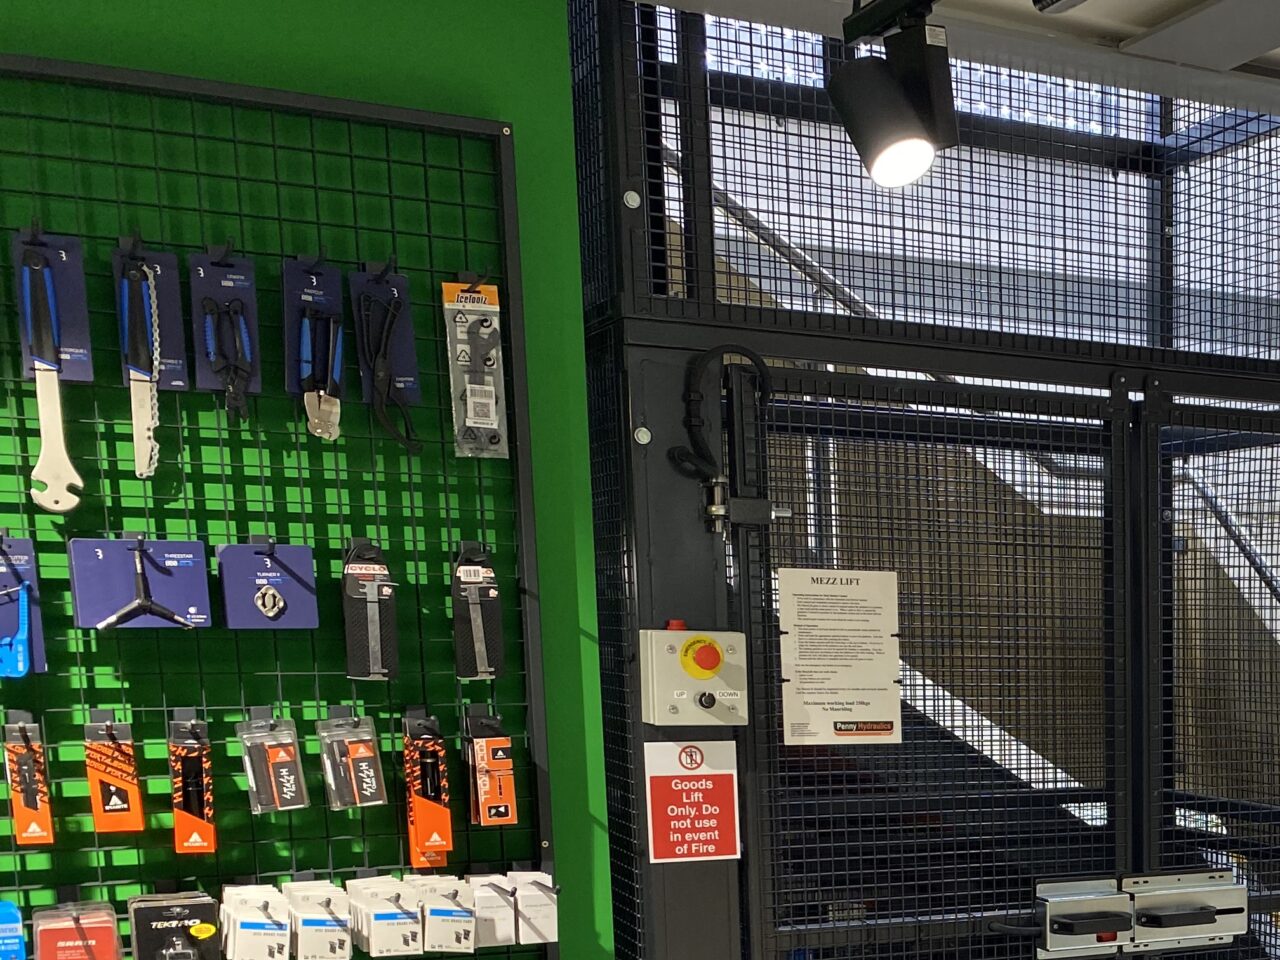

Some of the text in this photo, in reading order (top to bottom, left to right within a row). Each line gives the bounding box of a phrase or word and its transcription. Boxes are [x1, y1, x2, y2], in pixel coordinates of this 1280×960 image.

[810, 576, 860, 586] MEZZ LIFT
[836, 722, 891, 732] Penny Hydraulics
[671, 778, 713, 791] Goods
[682, 791, 703, 803] Lift
[667, 804, 720, 818] Only. Do
[670, 818, 717, 829] not use
[669, 830, 720, 842] in event
[675, 842, 716, 855] of Fire
[150, 918, 201, 929] TEKTRO
